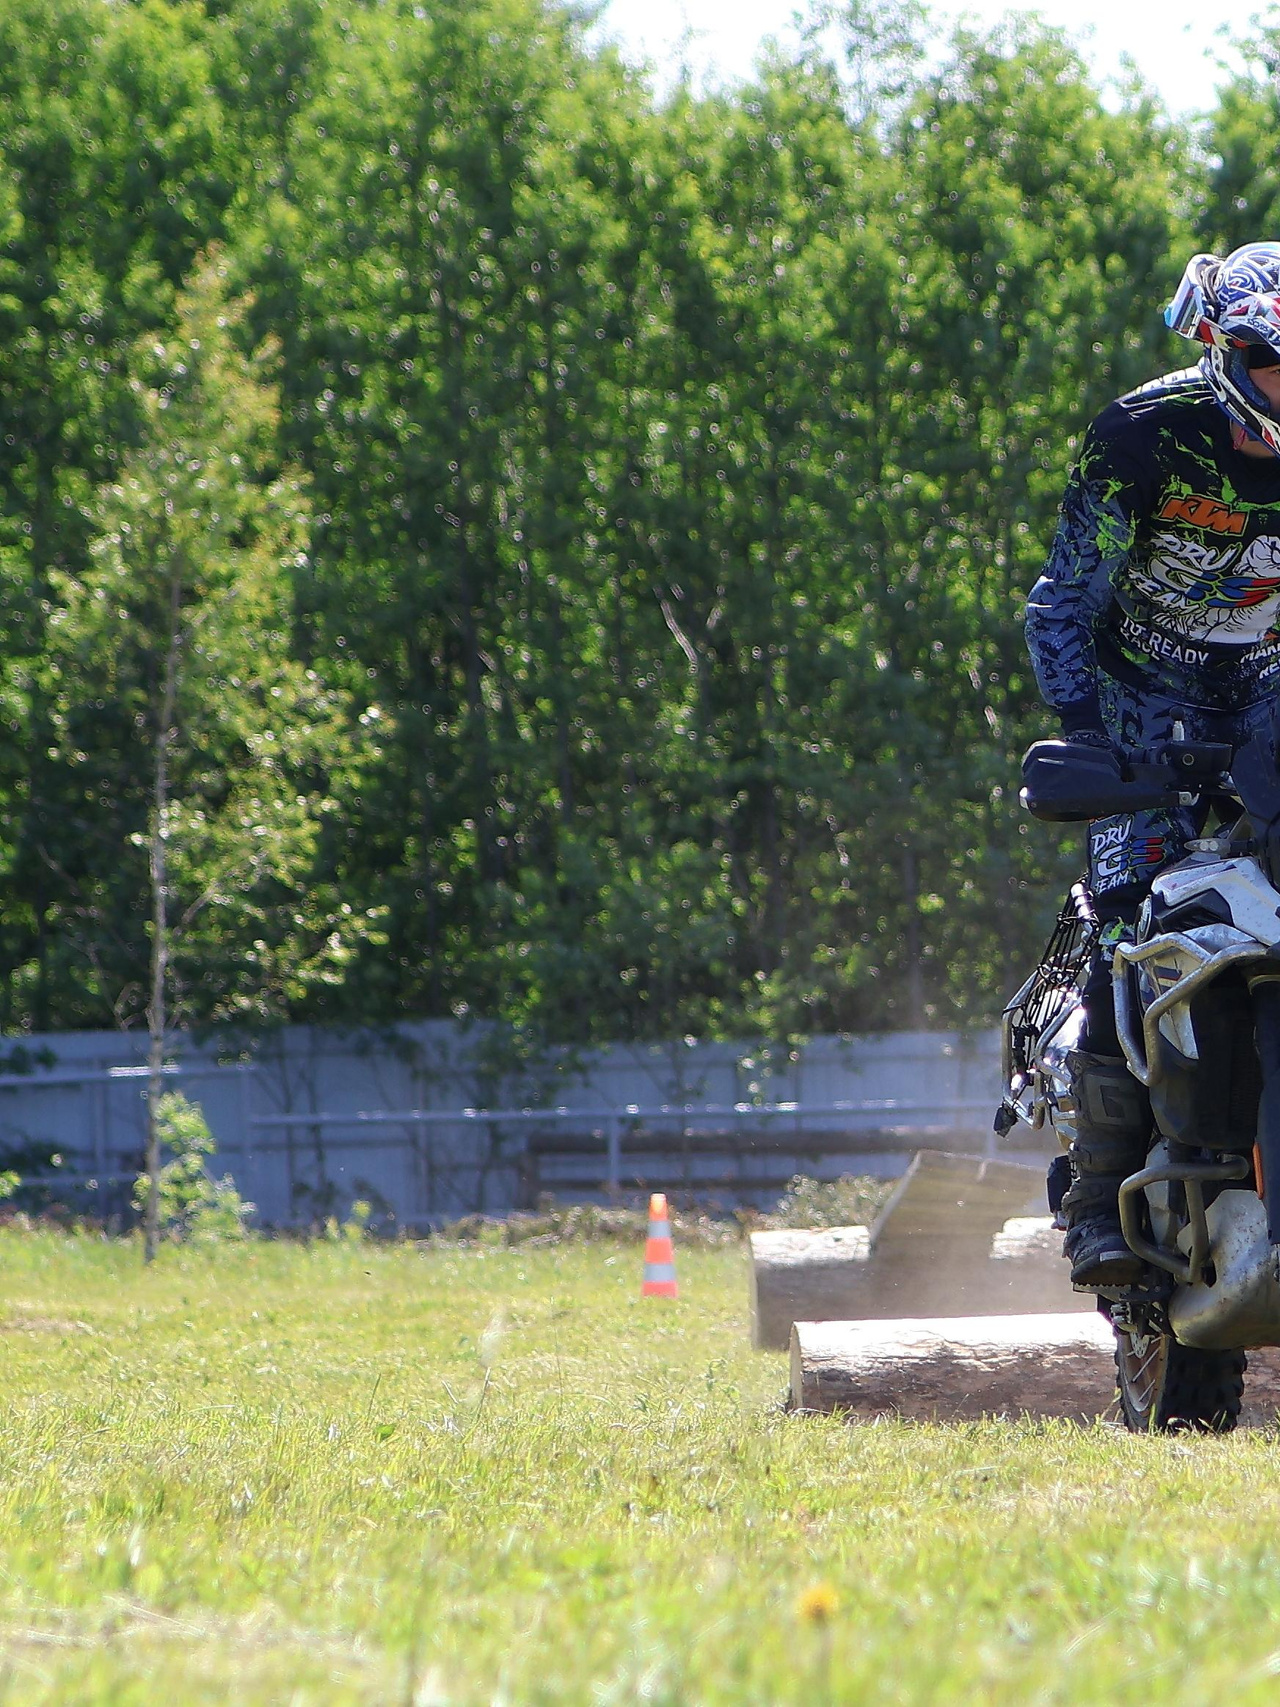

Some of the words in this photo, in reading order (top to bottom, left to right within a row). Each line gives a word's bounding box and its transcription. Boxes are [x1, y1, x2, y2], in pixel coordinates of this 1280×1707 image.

[1158, 494, 1249, 536] KTM
[1149, 631, 1209, 666] READY
[1091, 819, 1132, 856] DRU
[1095, 871, 1130, 895] TEAM
